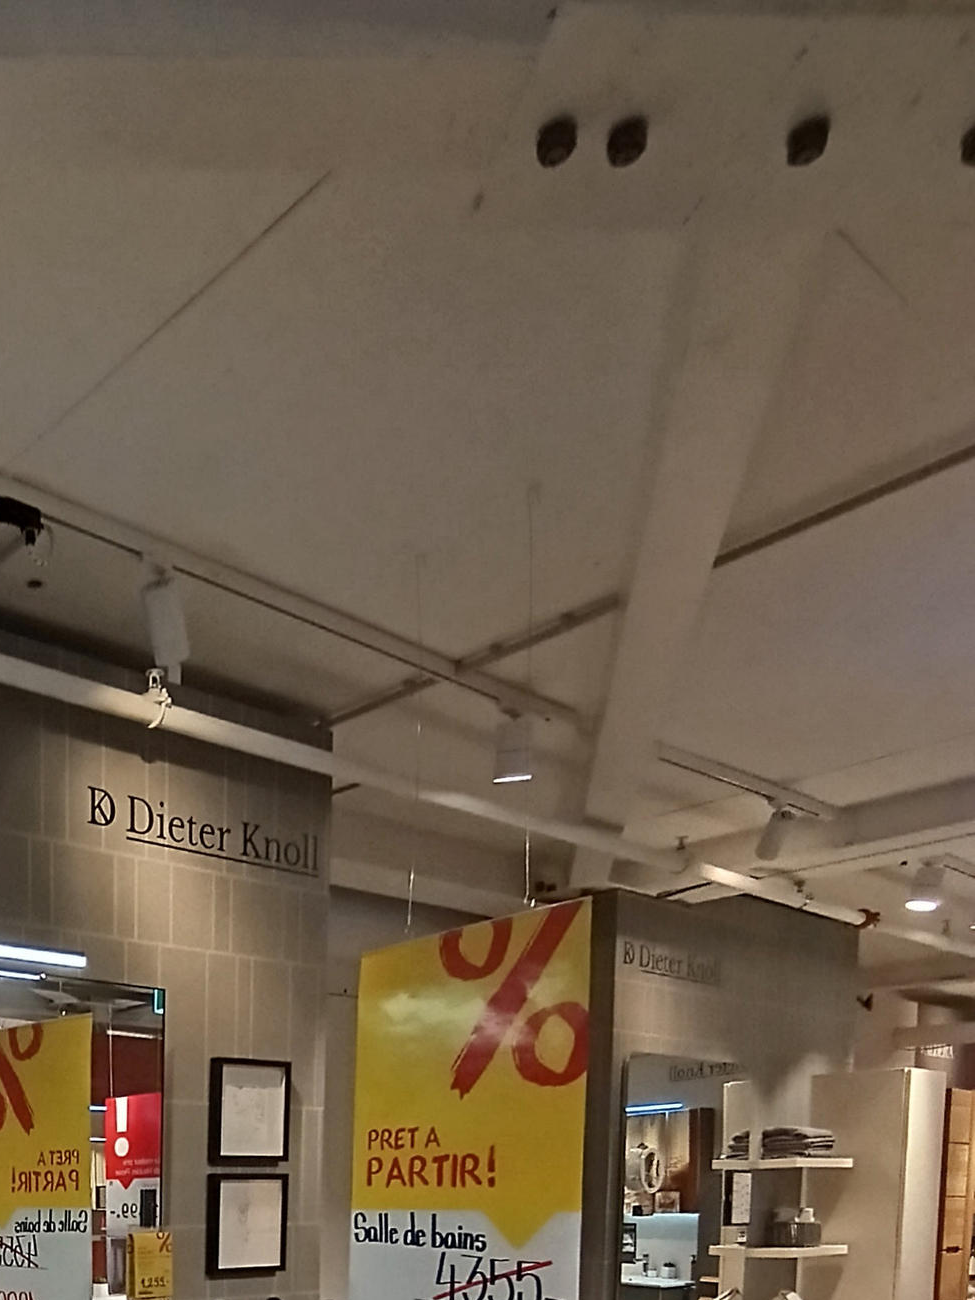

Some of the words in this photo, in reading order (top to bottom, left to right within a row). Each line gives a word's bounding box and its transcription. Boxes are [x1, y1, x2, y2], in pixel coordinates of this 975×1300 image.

[126, 795, 231, 852] Dieter
[241, 821, 319, 872] Knoll
[639, 944, 683, 974] Dieter
[368, 1127, 419, 1151] PRET
[425, 1126, 440, 1148] A
[366, 1145, 496, 1189] PARTIR!
[354, 1212, 399, 1245] Salle
[403, 1212, 426, 1246] de
[431, 1213, 487, 1252] bains
